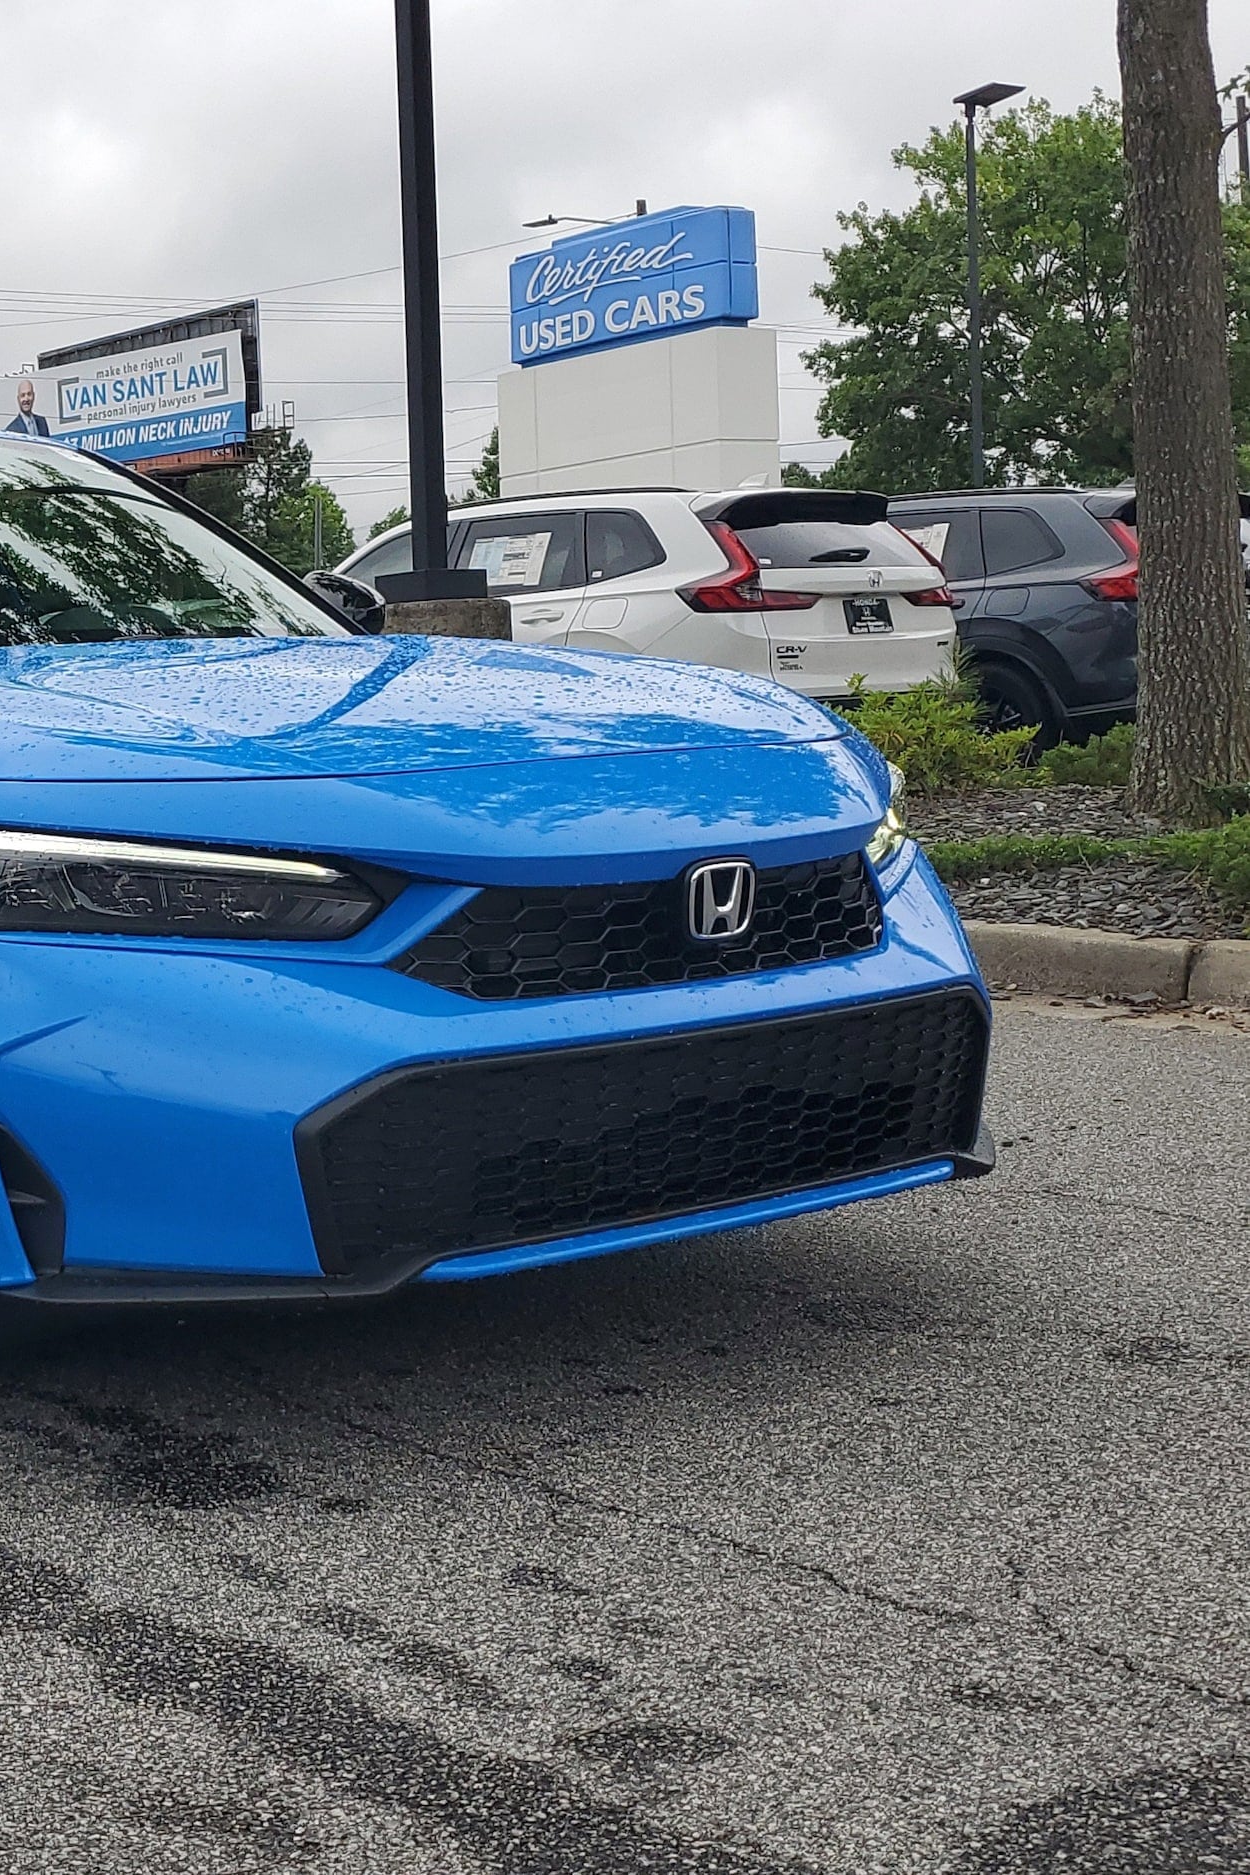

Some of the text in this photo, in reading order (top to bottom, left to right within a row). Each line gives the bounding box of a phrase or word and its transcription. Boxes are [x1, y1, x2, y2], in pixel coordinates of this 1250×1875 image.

[525, 231, 694, 306] Certified
[519, 285, 706, 355] USED CARS
[96, 351, 183, 379] make the right call
[65, 361, 218, 412] VAN SANT LAW
[87, 394, 197, 425] personal injury lawyers
[81, 429, 137, 452] MILLION
[138, 421, 177, 443] NECK
[179, 410, 231, 436] INJURY
[776, 645, 808, 654] CR-V
